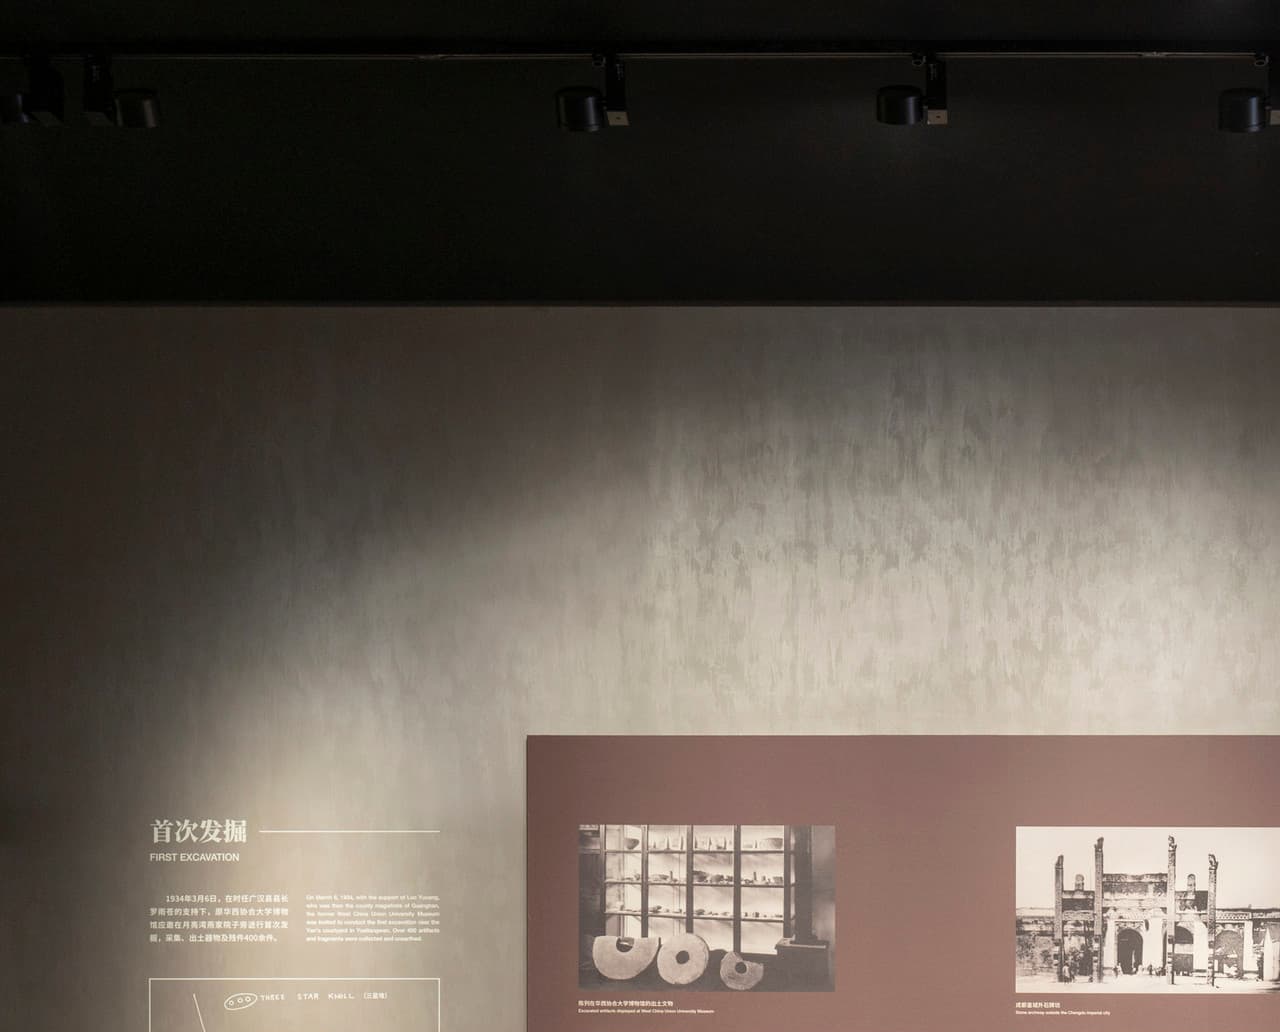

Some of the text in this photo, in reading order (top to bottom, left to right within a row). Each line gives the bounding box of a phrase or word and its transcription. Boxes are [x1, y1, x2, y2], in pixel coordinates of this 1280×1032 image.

[150, 818, 248, 844] 首次发掘
[150, 853, 240, 862] FIRST EXCAVATION
